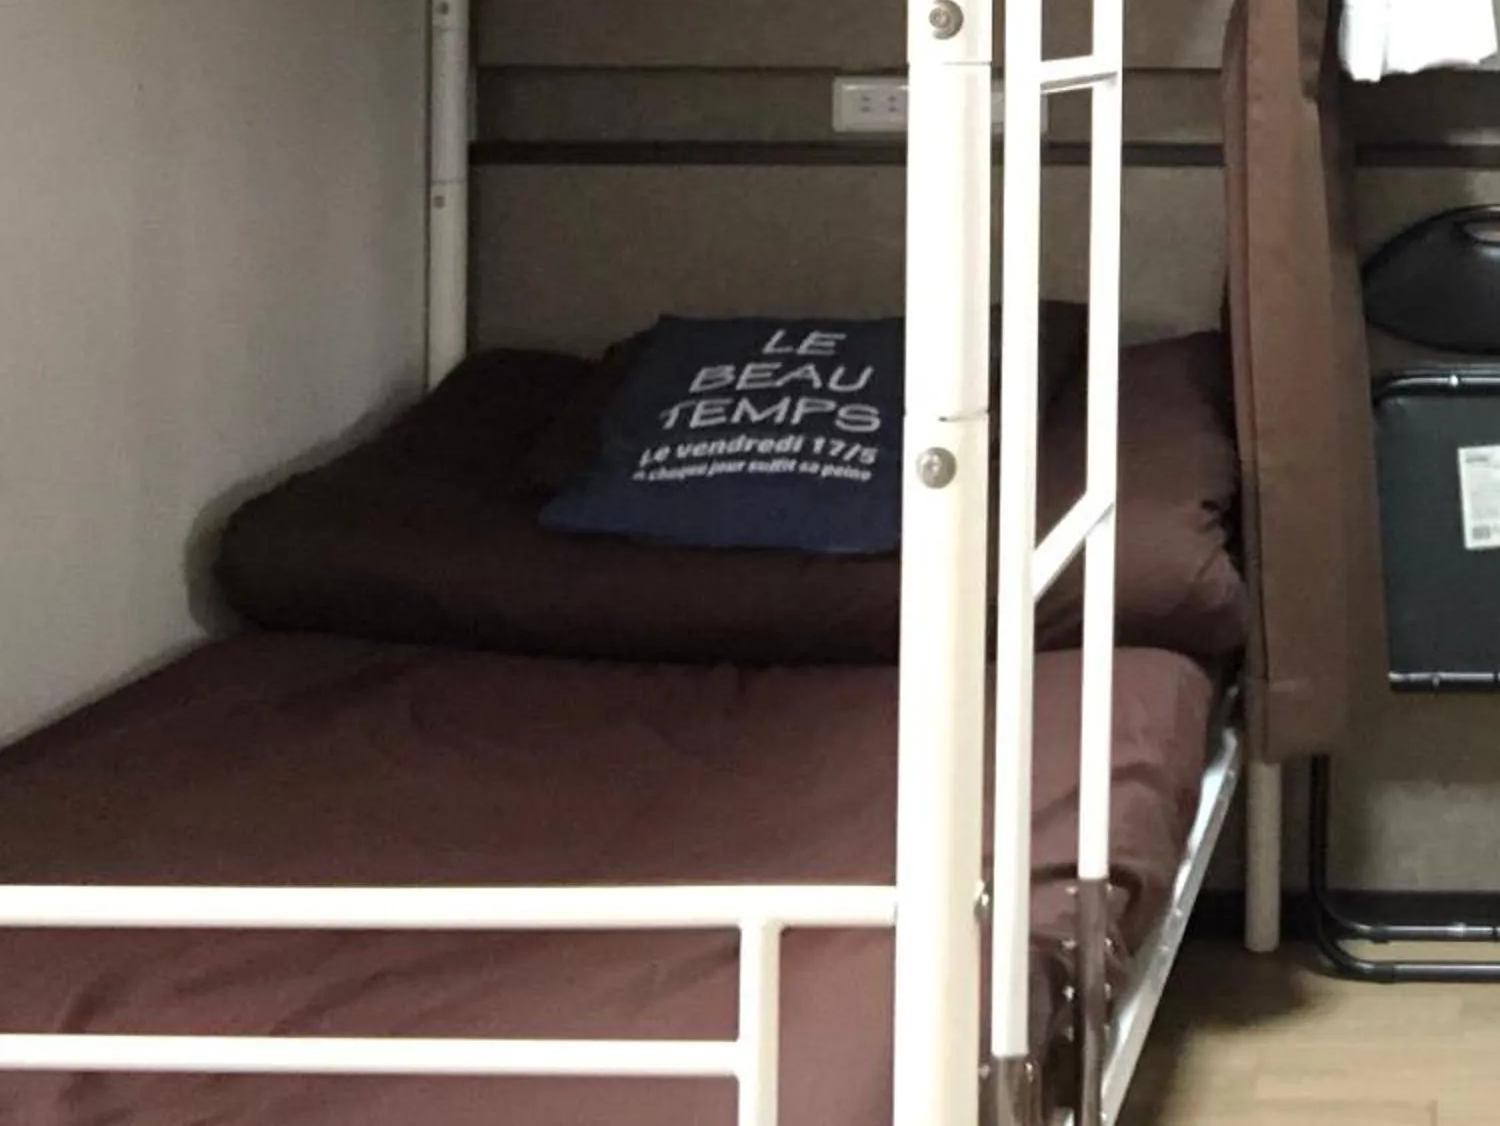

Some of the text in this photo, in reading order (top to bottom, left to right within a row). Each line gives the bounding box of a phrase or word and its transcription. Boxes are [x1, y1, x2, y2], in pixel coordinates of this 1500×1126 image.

[762, 329, 846, 355] LE
[689, 362, 874, 393] BEAU
[660, 396, 881, 432] TEMPS
[639, 434, 878, 466] Le vendredi 17/5
[706, 459, 746, 478] jour
